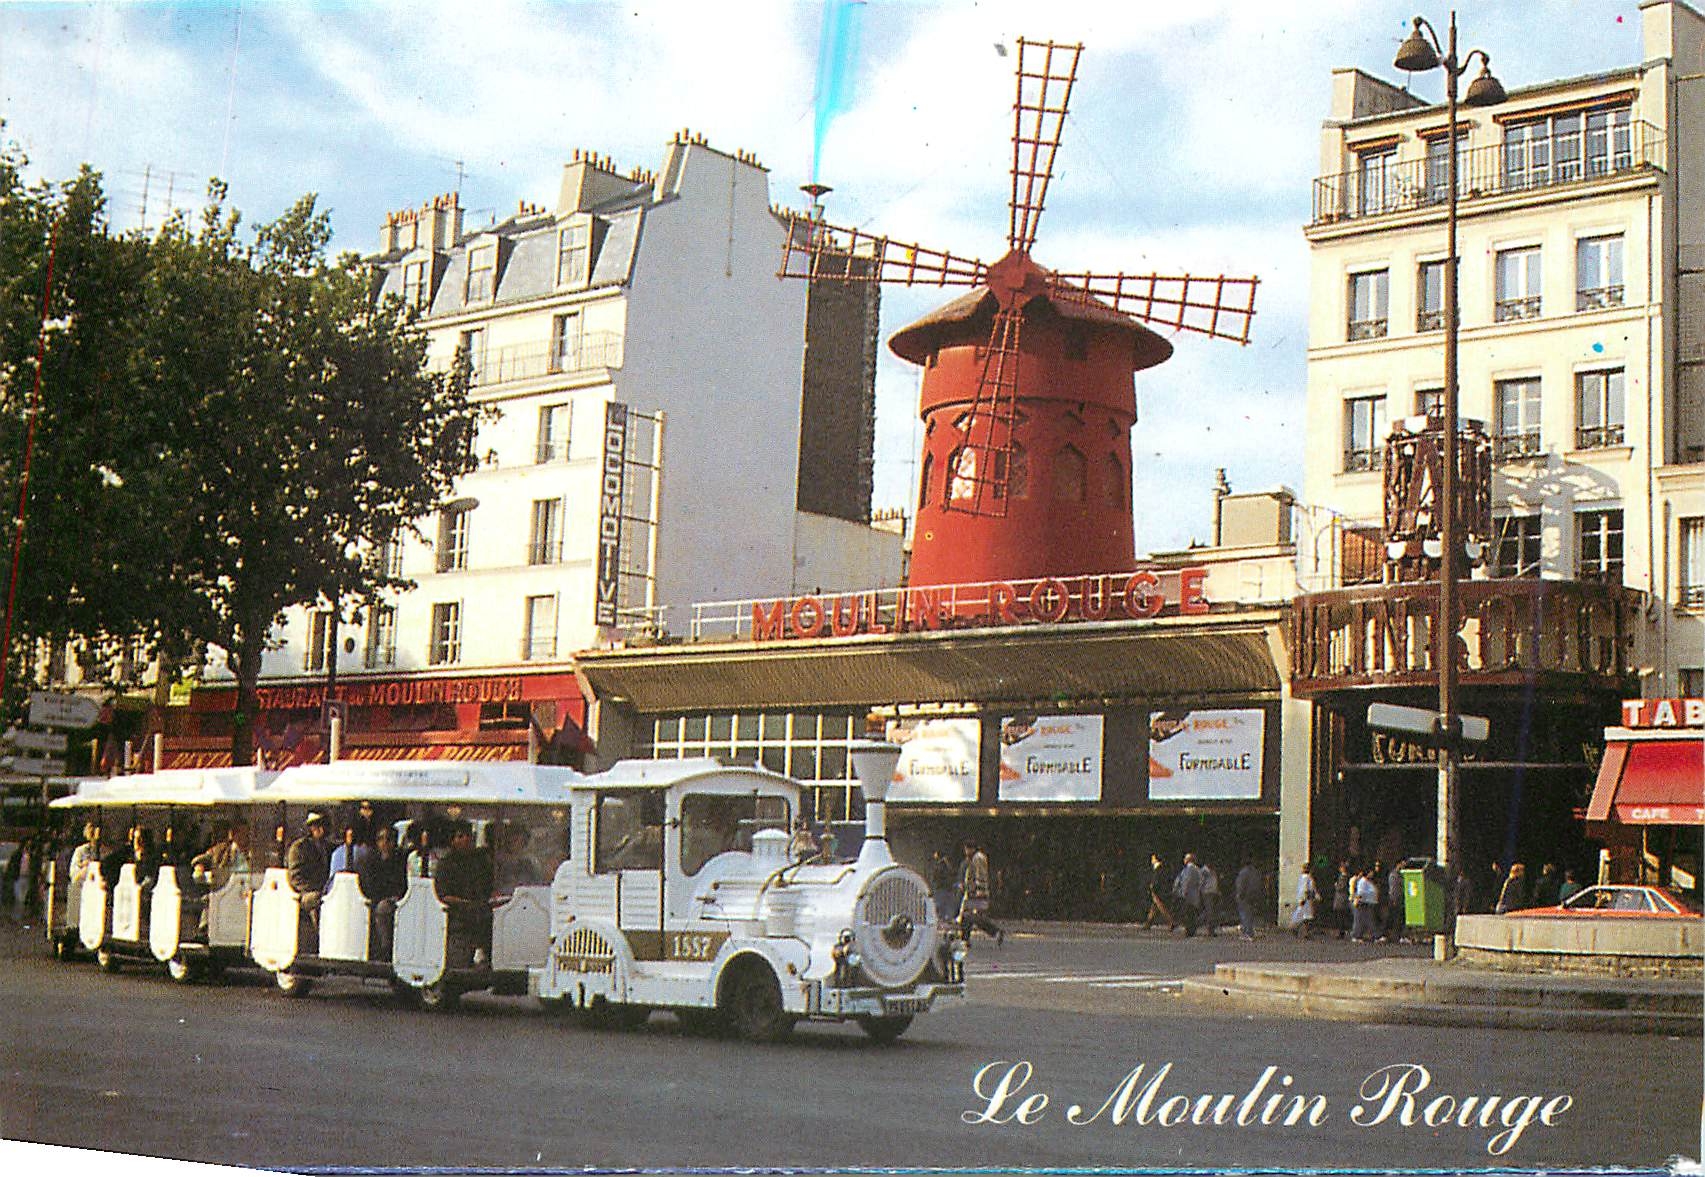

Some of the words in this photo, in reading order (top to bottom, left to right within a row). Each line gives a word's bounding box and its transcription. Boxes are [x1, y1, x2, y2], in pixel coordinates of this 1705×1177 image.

[598, 404, 625, 626] LOCOMOTIVE
[751, 587, 942, 642] MOULIN
[988, 568, 1210, 624] ROUGE
[369, 680, 446, 705] MOULIN
